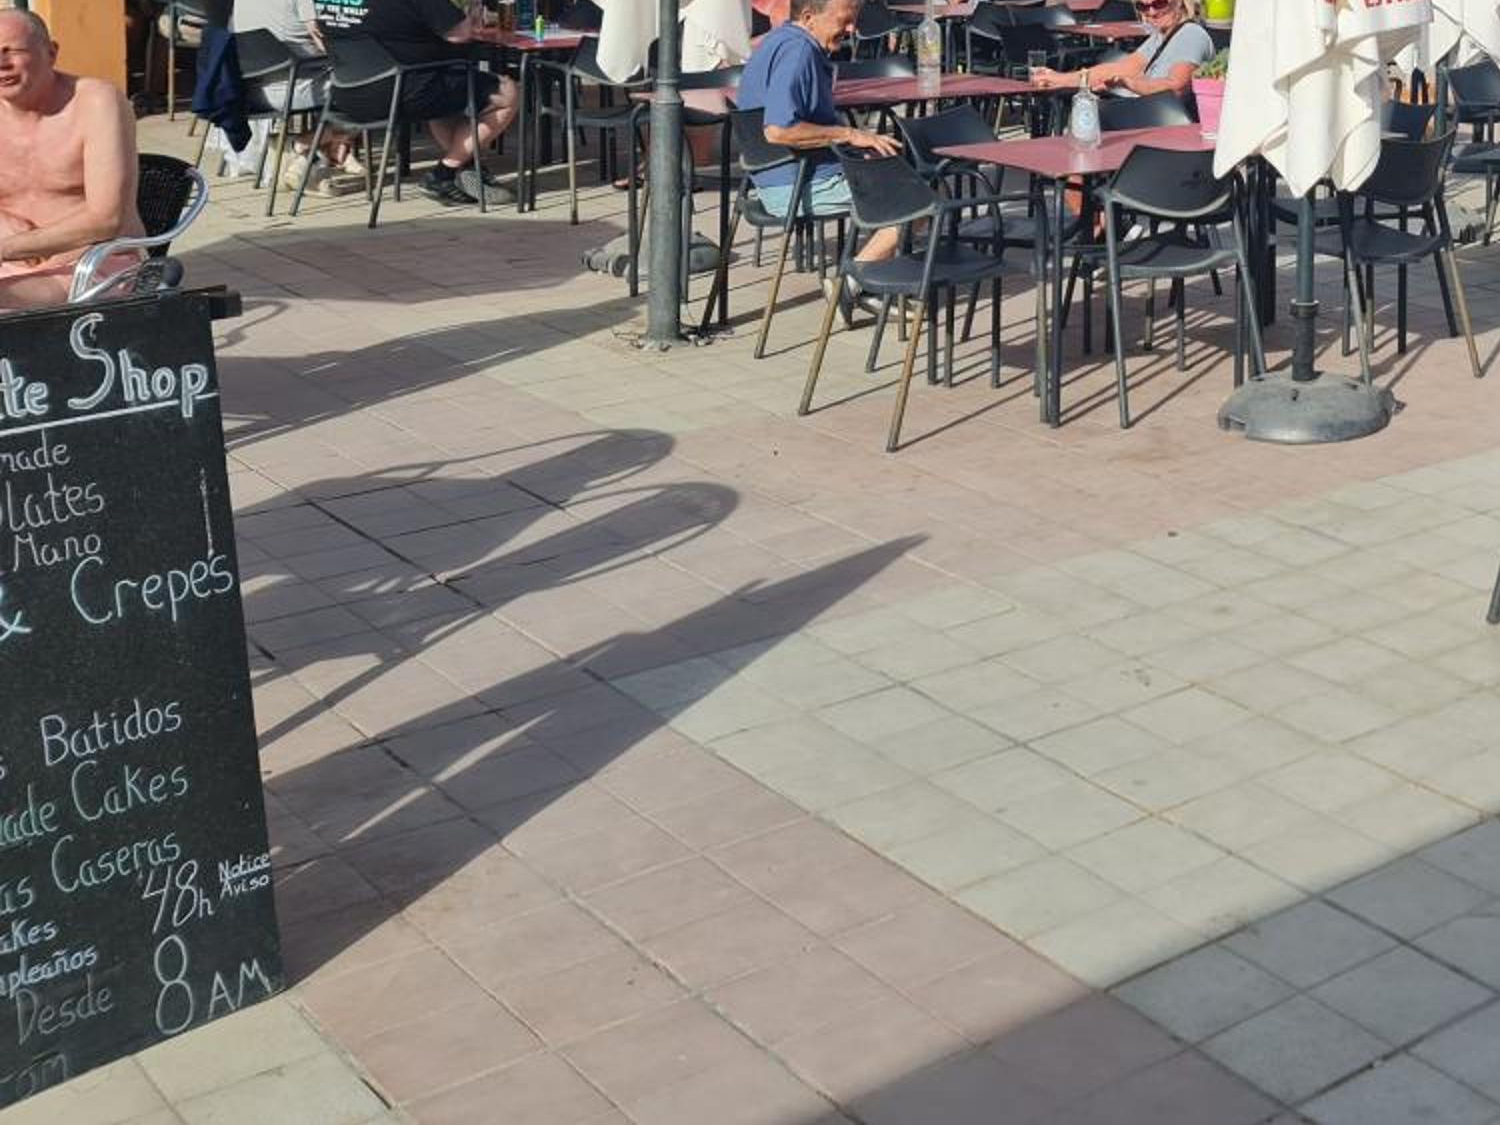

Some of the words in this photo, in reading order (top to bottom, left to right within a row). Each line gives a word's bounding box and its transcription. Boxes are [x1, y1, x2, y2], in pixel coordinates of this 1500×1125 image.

[0, 357, 48, 420] te
[68, 312, 208, 418] Shop
[0, 473, 105, 532] lates
[12, 532, 101, 572] Mano
[71, 555, 233, 623] Crepes
[40, 697, 183, 767] Batidos
[0, 783, 59, 845] ade
[71, 759, 188, 821] Cakes
[51, 832, 181, 893] Caseras
[218, 853, 271, 883] Notice
[220, 874, 269, 900] Aviso
[15, 972, 113, 1046] Desde
[154, 934, 194, 1035] 8
[207, 957, 272, 1020] AM
